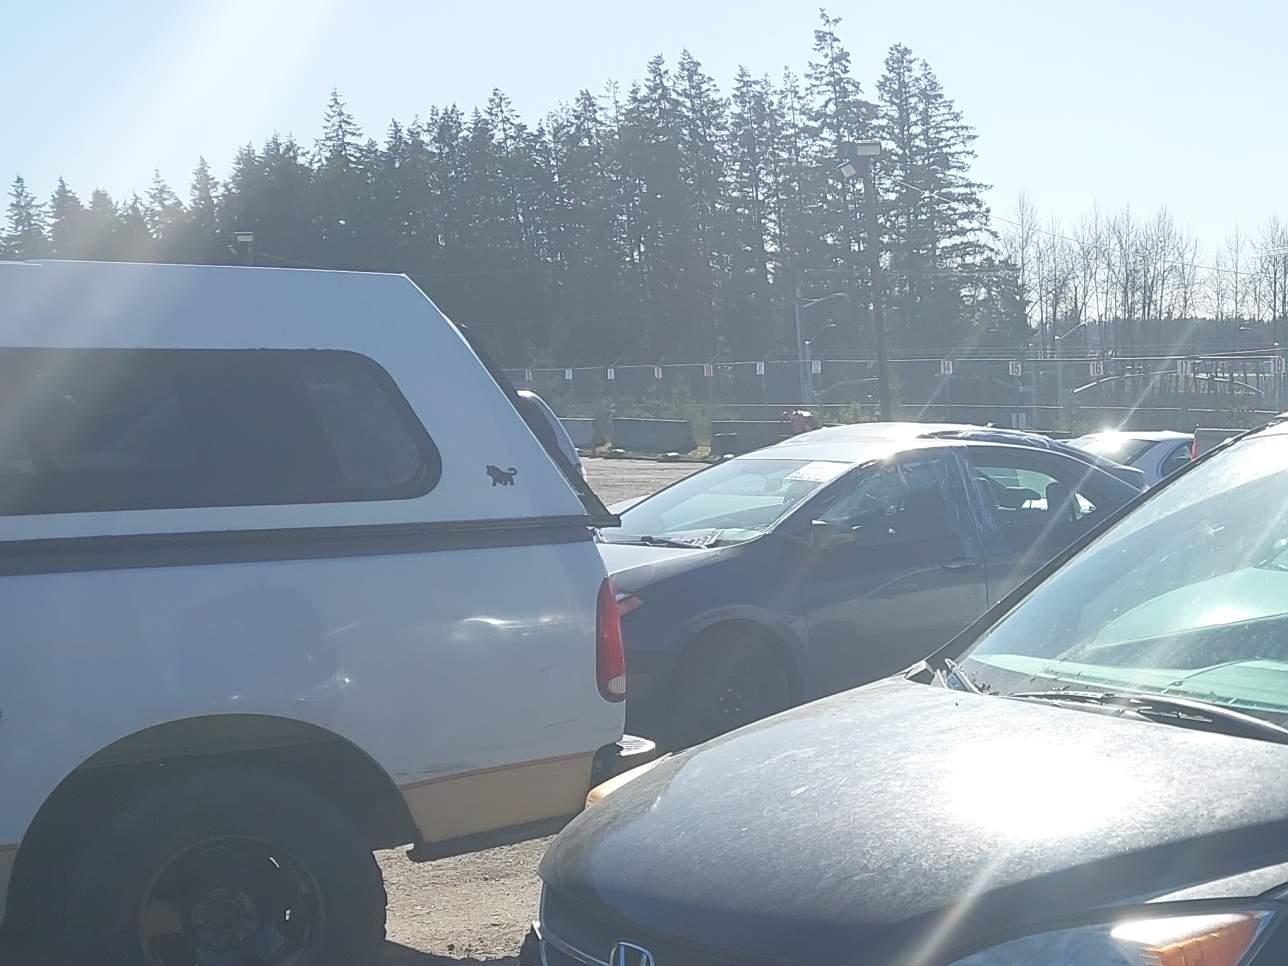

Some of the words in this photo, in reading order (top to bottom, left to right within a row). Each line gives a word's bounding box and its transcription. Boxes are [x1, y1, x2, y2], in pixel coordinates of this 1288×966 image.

[1010, 362, 1021, 375] 15
[1091, 362, 1102, 375] 16
[1179, 361, 1190, 375] 17
[1273, 359, 1284, 372] 18
